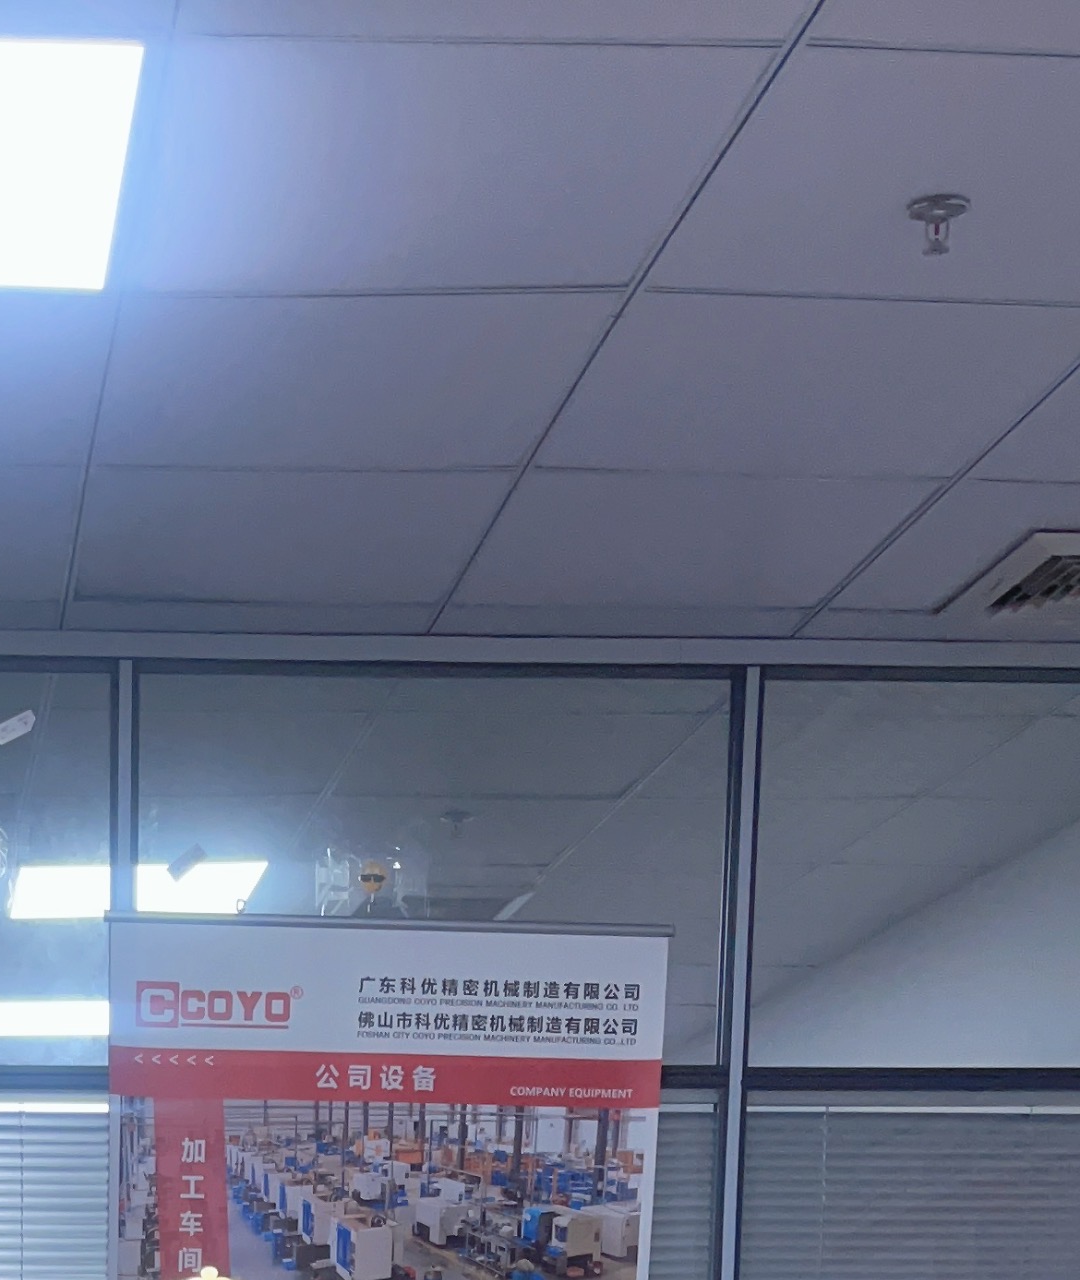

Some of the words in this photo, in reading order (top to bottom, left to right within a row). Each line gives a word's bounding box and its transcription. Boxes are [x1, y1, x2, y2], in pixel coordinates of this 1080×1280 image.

[358, 976, 641, 1001] 广东科优精密机械制造有限公司
[358, 996, 412, 1006] GUANGDONG
[414, 998, 437, 1006] COYO
[440, 999, 483, 1007] PRECISION
[485, 1000, 533, 1009] MACHINERY
[535, 1001, 604, 1011] MANUFACTURING
[357, 1010, 638, 1036] 佛山市科优精密机械制造有限公司
[357, 1031, 390, 1040] FOSHAN
[392, 1031, 410, 1040] CITY
[412, 1032, 436, 1040] COYO
[438, 1033, 481, 1042] PRECISION
[483, 1034, 531, 1043] MACHINERY
[533, 1036, 602, 1045] MANUFACTURING
[315, 1064, 437, 1092] 公司设备
[510, 1086, 567, 1098] COMPANY
[569, 1087, 634, 1099] EQUIPMENT
[178, 1137, 206, 1273] 加工车间
